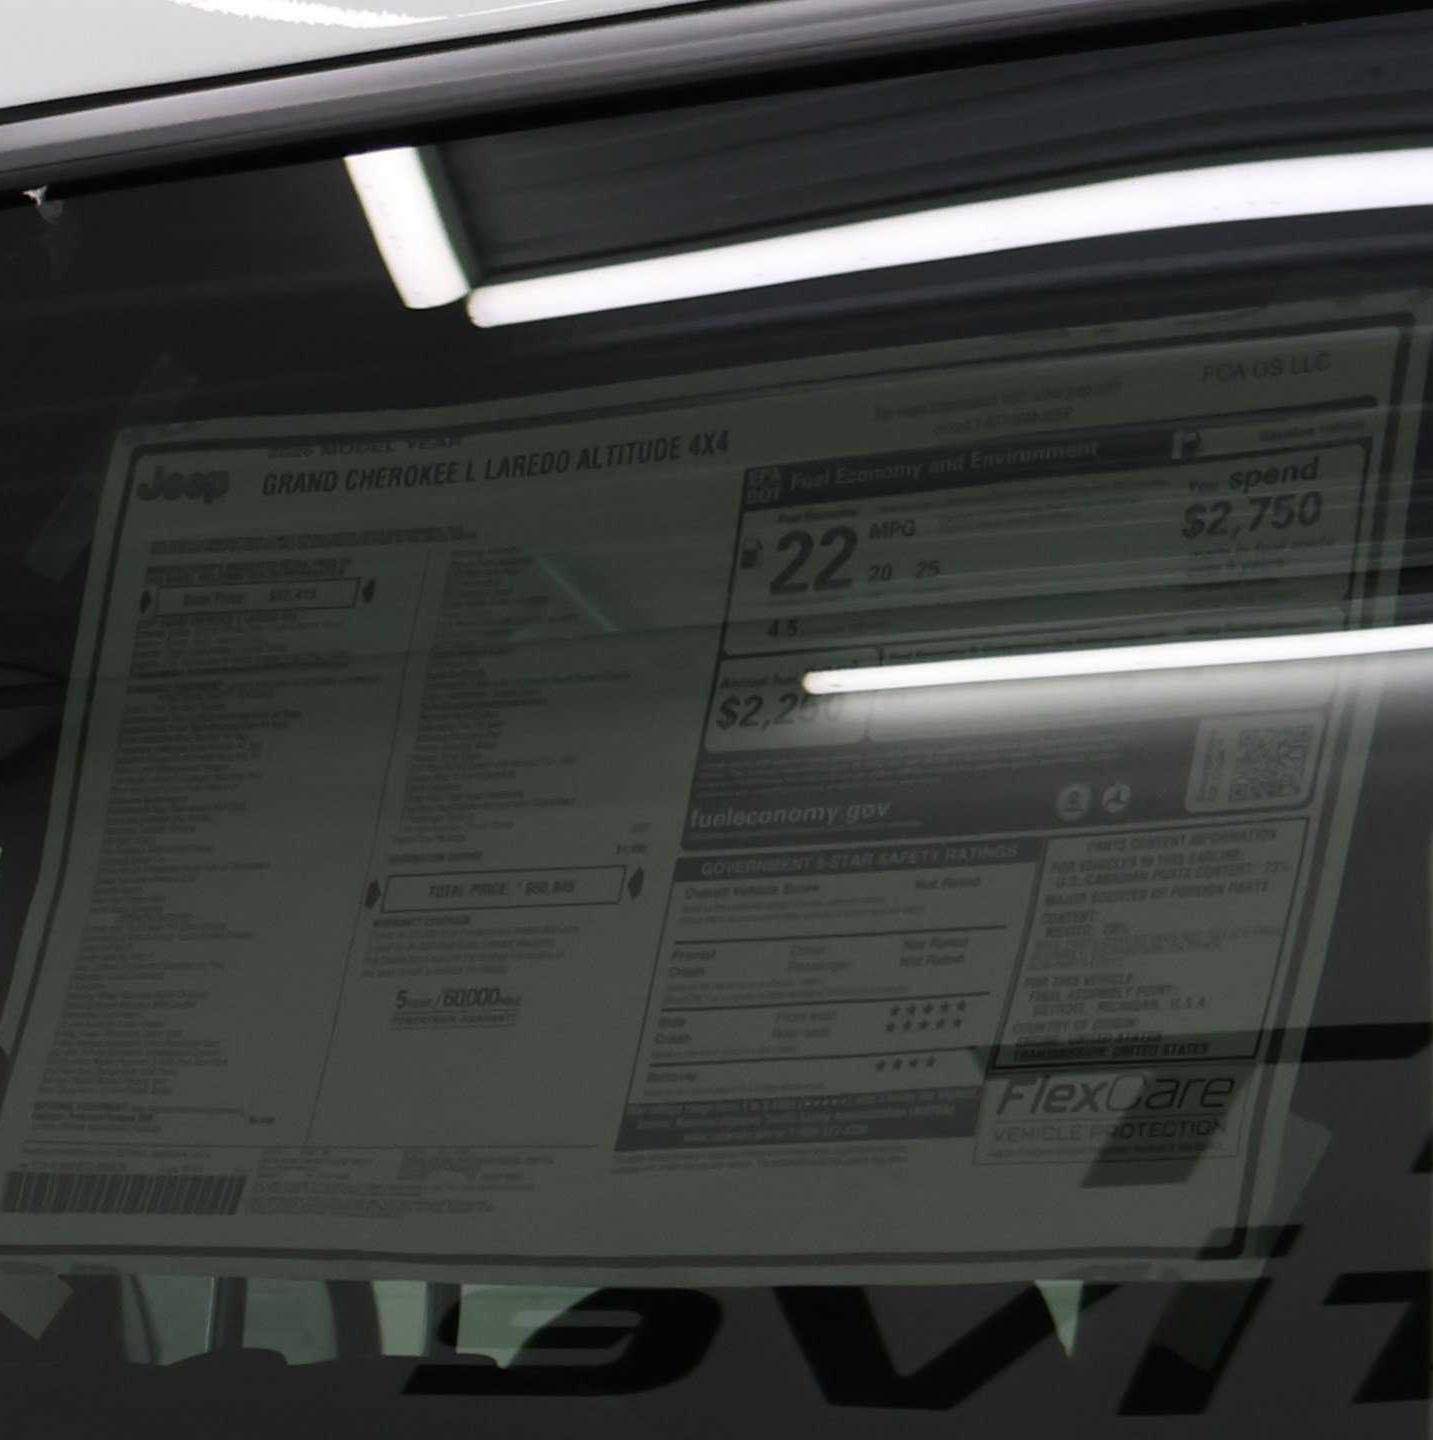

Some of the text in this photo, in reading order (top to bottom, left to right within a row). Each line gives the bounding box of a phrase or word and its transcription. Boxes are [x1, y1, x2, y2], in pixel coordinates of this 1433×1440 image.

[1202, 352, 1331, 383] FCA US LLC
[262, 430, 729, 496] GRAND CHEROKEE L LAREDO ALTITUDE 4X4
[748, 467, 781, 485] EPA
[790, 441, 1100, 490] Fuel Economy and Environment
[1229, 456, 1319, 493] spend
[136, 465, 230, 504] Jeep
[747, 488, 781, 504] DOT
[869, 518, 915, 541] MPG
[1182, 491, 1323, 540] $2,750
[769, 524, 858, 596] 22
[868, 563, 893, 584] 20
[915, 560, 940, 580] 25
[690, 802, 890, 829] fueleconomy.gov
[701, 844, 1018, 877] GOVERNMENT 5-STAR SAFETY RATINGS
[429, 884, 464, 898] TOTAL
[996, 1073, 1235, 1115] FlexCare
[992, 1118, 1225, 1143] VEHICLE PROTECTION
